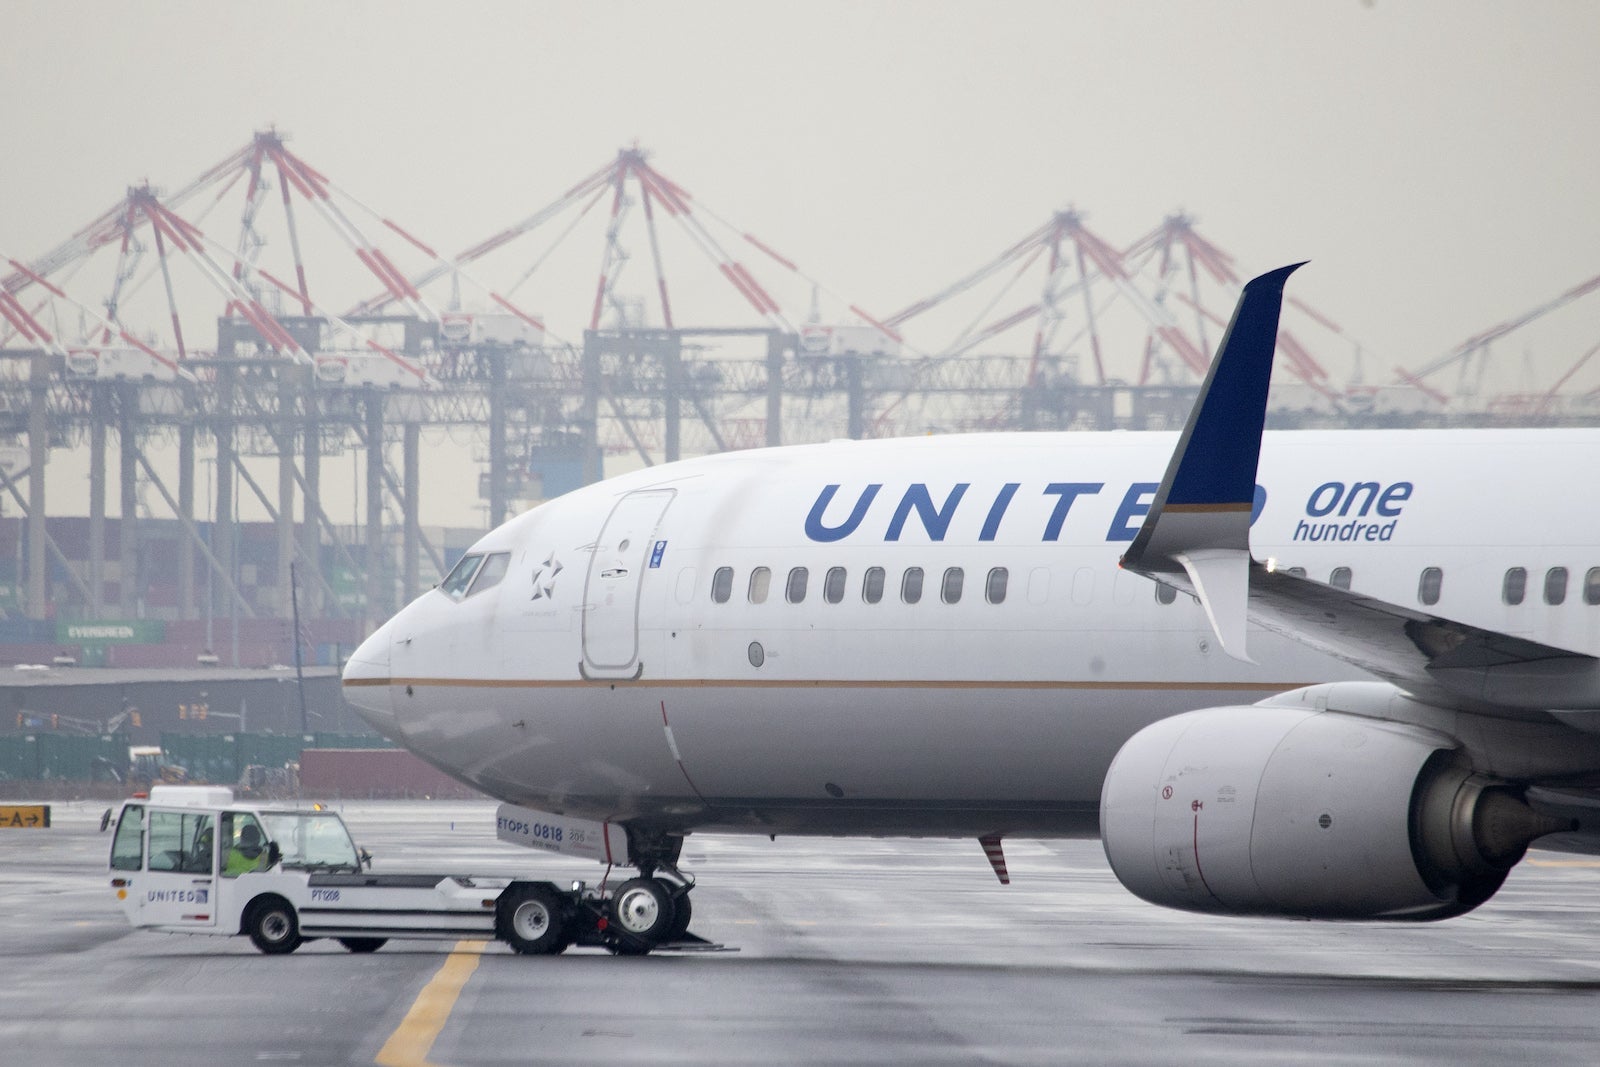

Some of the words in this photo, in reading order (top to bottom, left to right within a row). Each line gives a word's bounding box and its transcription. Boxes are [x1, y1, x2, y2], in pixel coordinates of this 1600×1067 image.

[1305, 481, 1414, 517] one
[1292, 519, 1398, 541] hundred
[68, 626, 134, 638] EVERGREEN
[10, 811, 24, 827] A
[497, 818, 529, 835] ETOPS
[533, 823, 563, 841] 0818
[147, 890, 194, 902] UNITED
